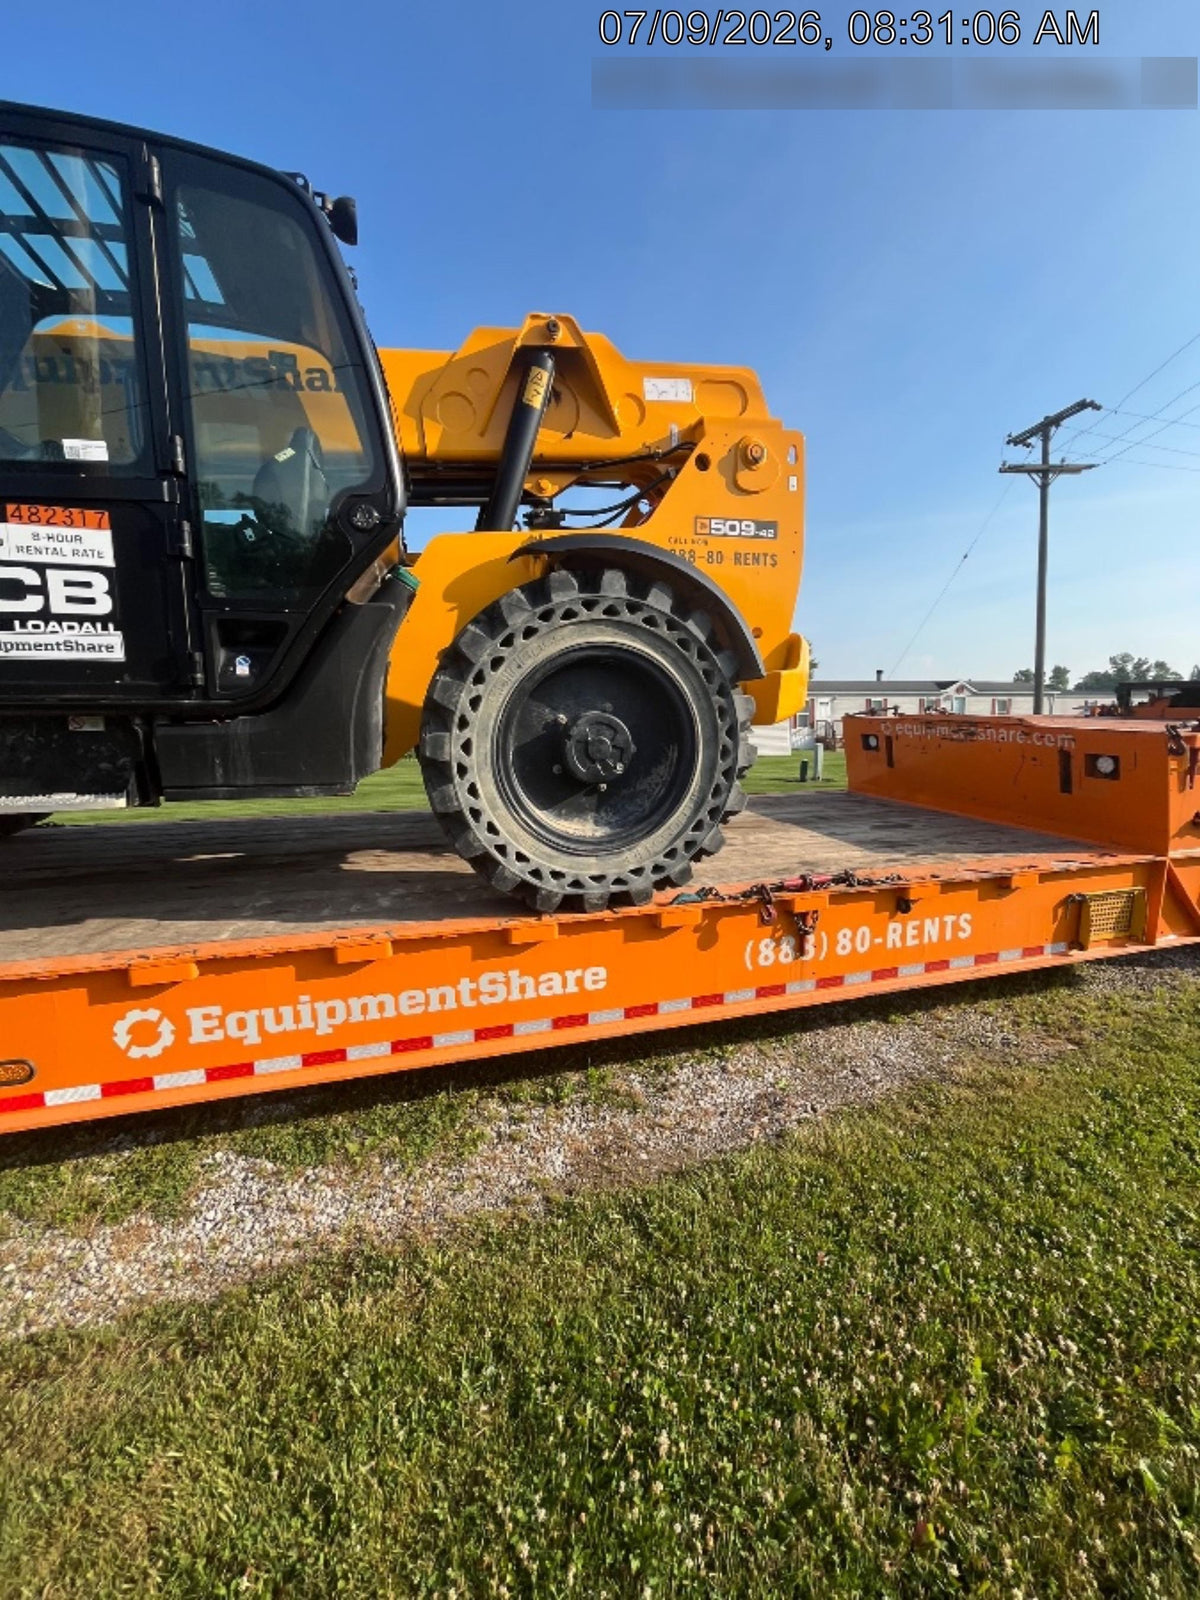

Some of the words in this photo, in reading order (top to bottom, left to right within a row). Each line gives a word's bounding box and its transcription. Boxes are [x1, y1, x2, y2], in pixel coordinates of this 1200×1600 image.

[9, 504, 106, 529] 482317
[31, 532, 83, 544] 8-HOUR
[16, 544, 68, 557] RENTAL
[71, 547, 105, 559] RATE
[13, 620, 119, 634] LOADALL
[836, 912, 973, 957] 80-RENTS
[187, 966, 607, 1045] EquipmentShare
